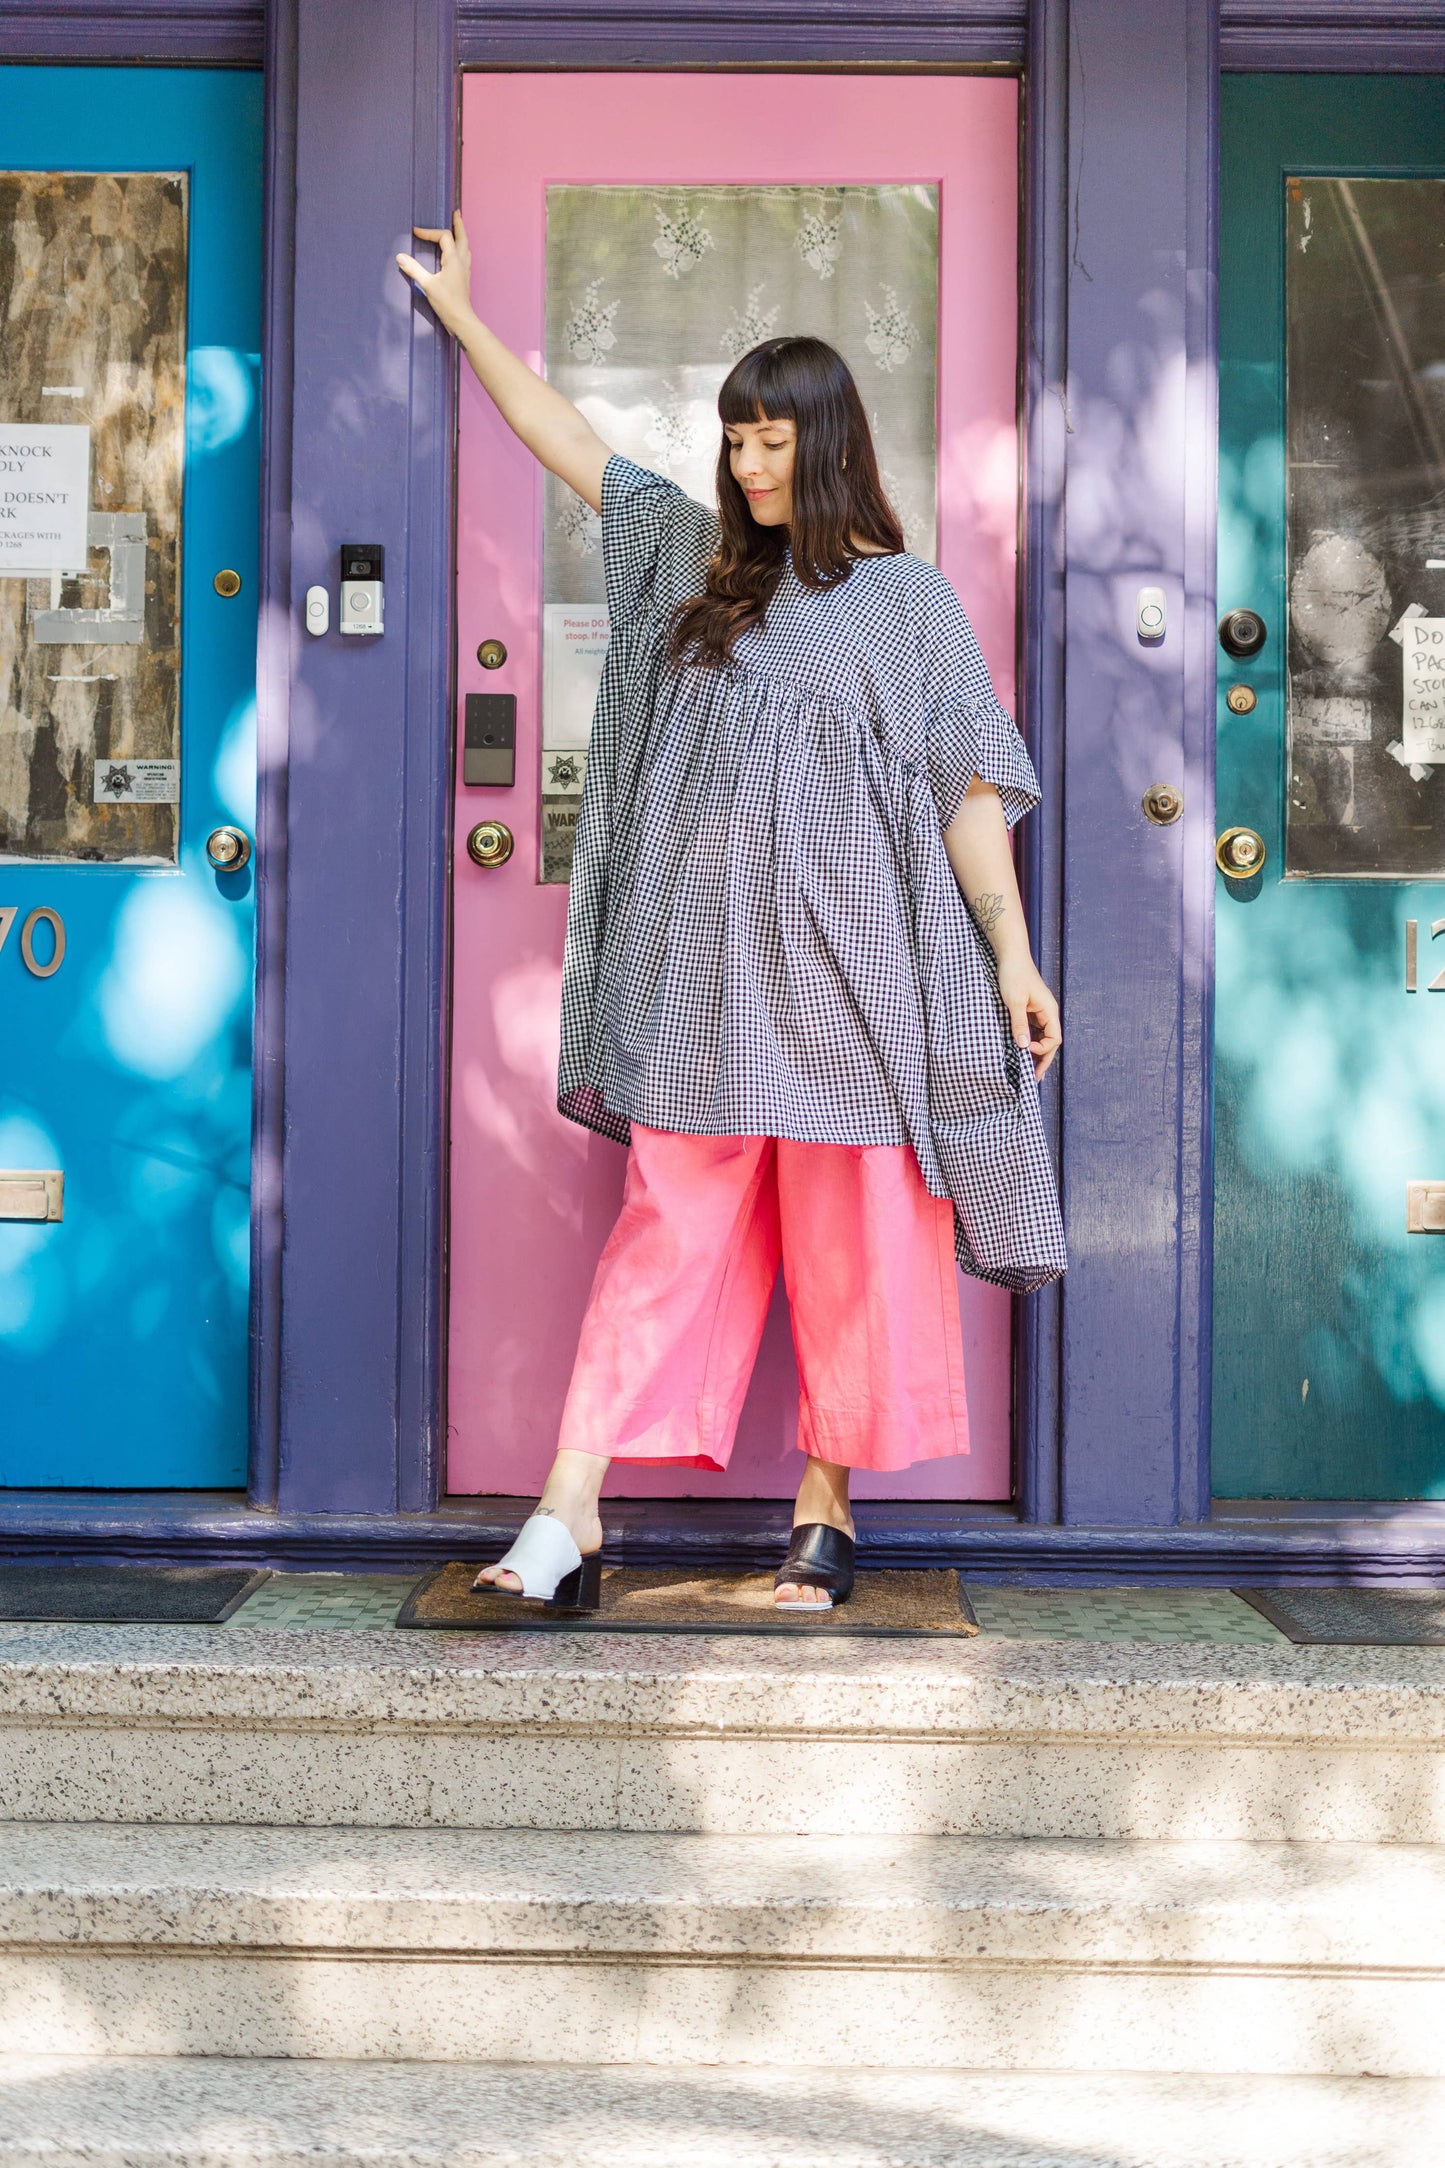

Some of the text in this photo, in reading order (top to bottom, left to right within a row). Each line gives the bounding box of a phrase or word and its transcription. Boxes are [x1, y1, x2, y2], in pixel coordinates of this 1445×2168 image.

[4, 492, 69, 504] DOESN'T
[37, 531, 61, 541] WITH
[563, 619, 590, 628] Please
[592, 619, 605, 628] DO
[566, 632, 590, 641] stoop.
[1415, 626, 1444, 645] DO
[1408, 699, 1438, 711] CAN
[548, 813, 580, 827] WAR
